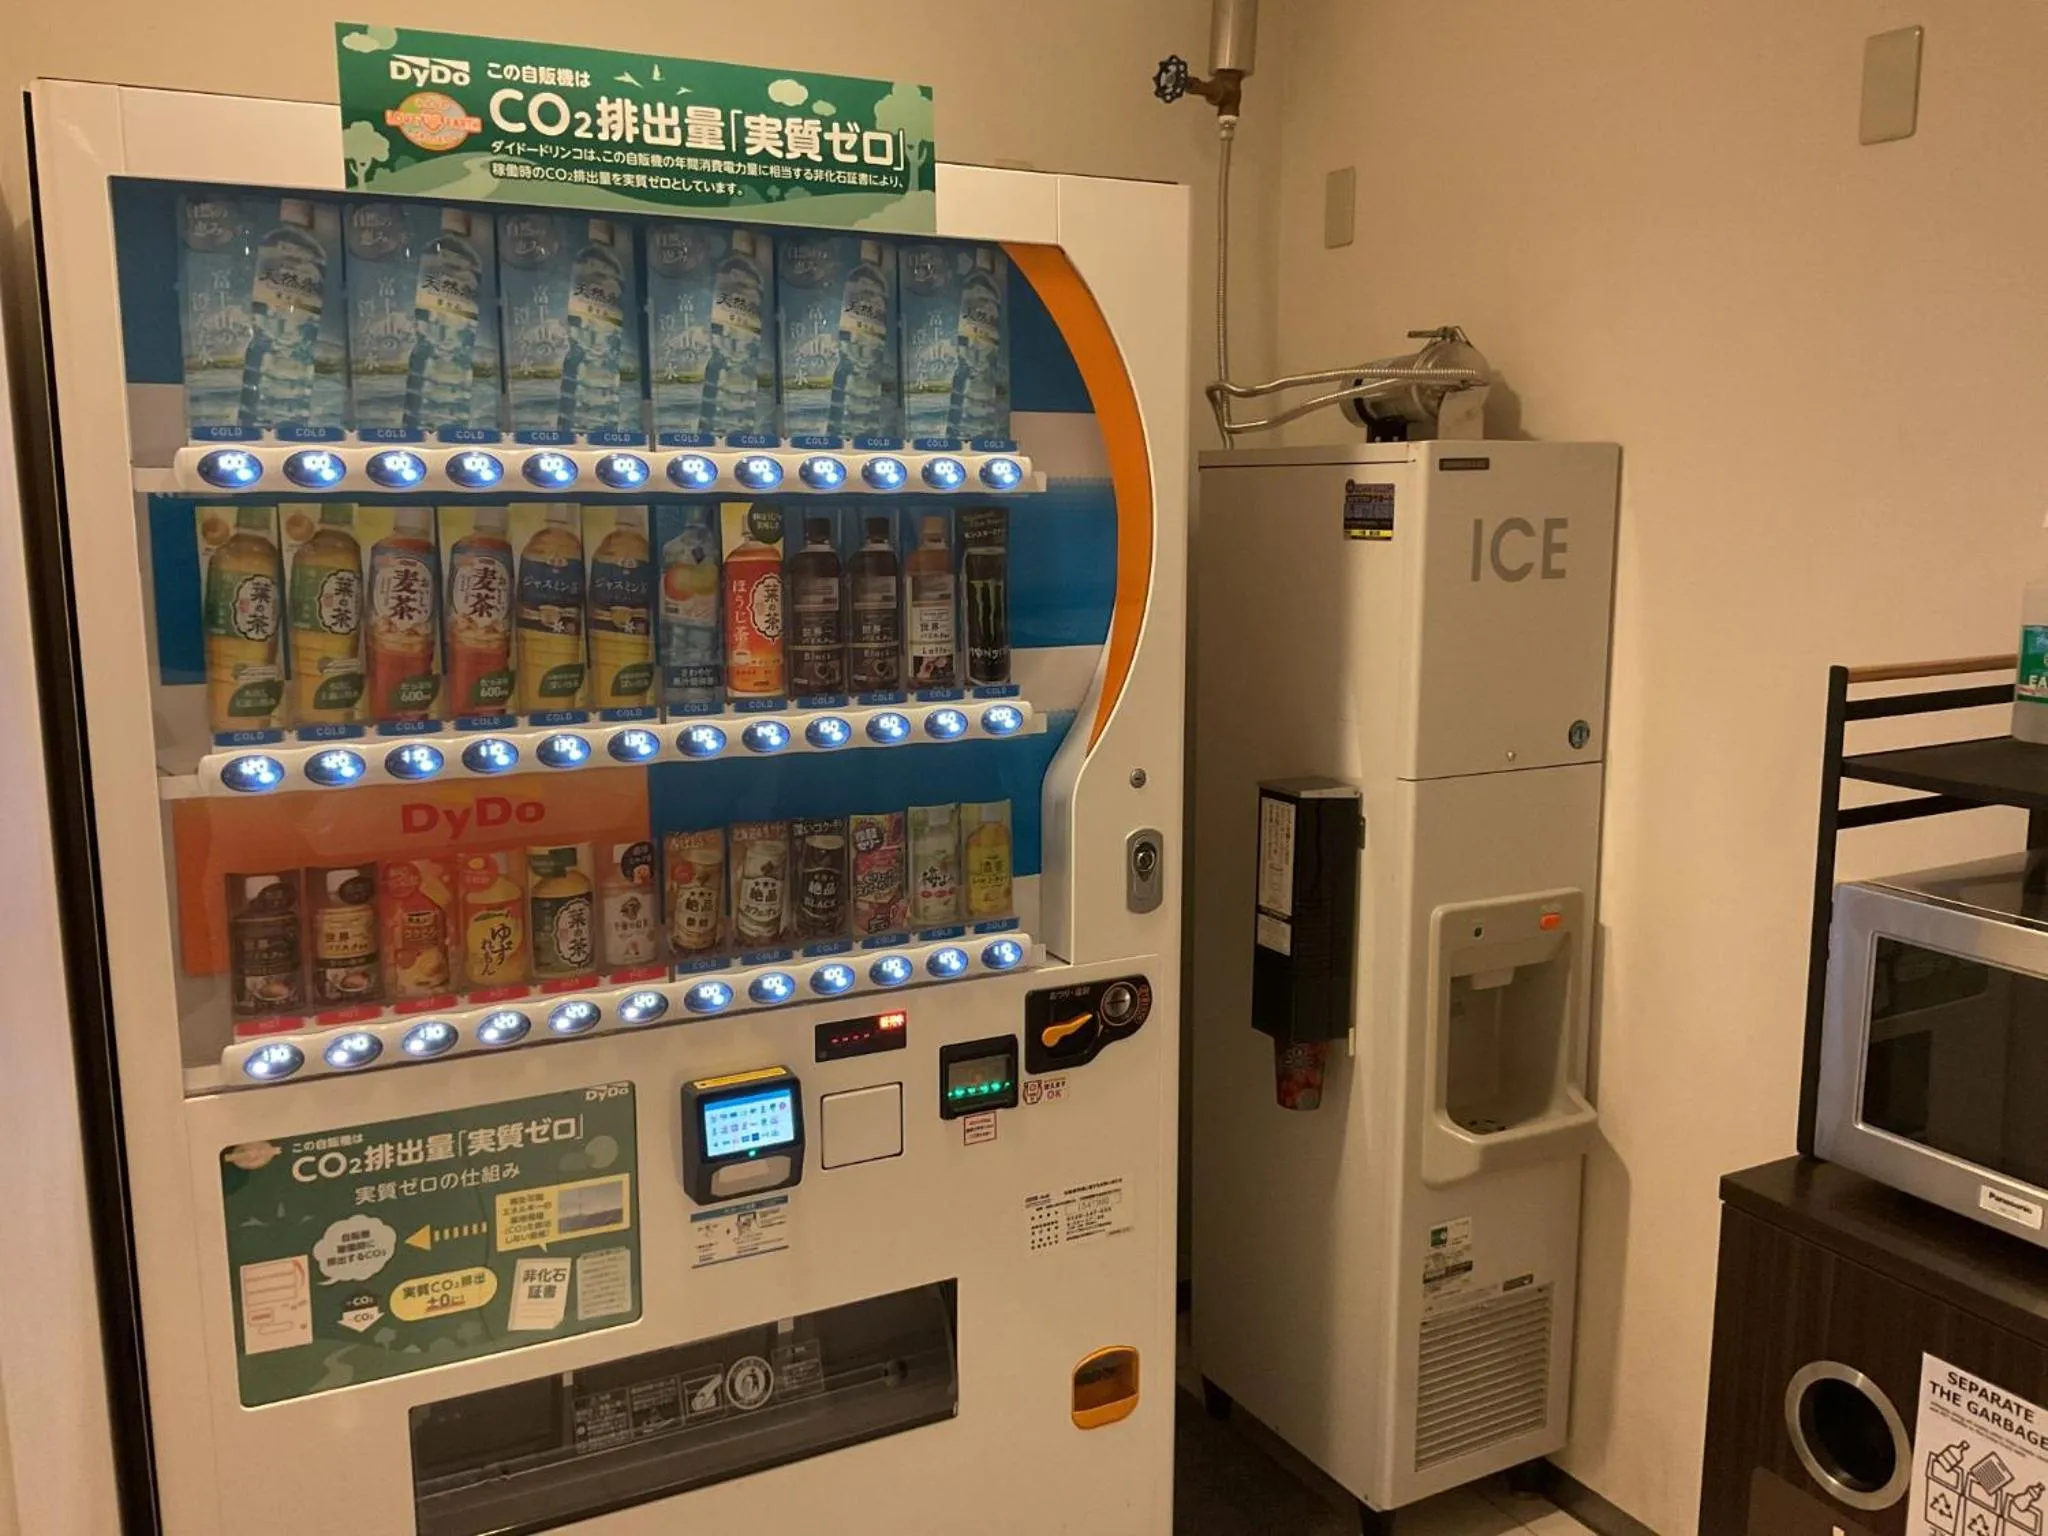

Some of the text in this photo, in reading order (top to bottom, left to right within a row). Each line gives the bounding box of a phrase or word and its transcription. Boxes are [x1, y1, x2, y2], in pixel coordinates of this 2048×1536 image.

[389, 55, 470, 87] DyDo
[487, 62, 591, 88] この自販機は
[211, 427, 242, 437] COLD
[296, 428, 326, 438] COLD
[377, 428, 407, 439] COLD
[456, 430, 485, 440] COLD
[531, 431, 559, 441] COLD
[604, 432, 630, 443] COLD
[674, 433, 700, 443] COLD
[741, 435, 766, 444] COLD
[805, 436, 829, 446] COLD
[868, 438, 890, 447] COLD
[926, 438, 949, 448] COLD
[983, 440, 1004, 449] COLD
[217, 453, 243, 470] 100
[303, 454, 329, 470] 100
[384, 455, 410, 471] 100
[463, 456, 488, 471] 100
[539, 458, 564, 472] 100
[613, 459, 634, 472] 100
[682, 459, 704, 473] 100
[749, 459, 769, 473] 100
[812, 460, 834, 474] 100
[874, 460, 896, 474] 100
[934, 460, 953, 474] 100
[990, 461, 1011, 475] 100
[1470, 517, 1569, 583] ICE
[388, 568, 421, 620] 麦茶
[469, 567, 500, 618] 麦茶
[246, 580, 273, 635] 葉の茶
[329, 576, 356, 629] 葉の茶
[764, 583, 781, 632] 葉の茶
[616, 708, 642, 718] COLD
[683, 703, 709, 713] COLD
[989, 708, 1012, 722] 200
[471, 716, 500, 727] COLD
[546, 712, 573, 722] COLD
[316, 726, 346, 737] COLD
[395, 721, 425, 731] COLD
[233, 732, 264, 742] COLD
[691, 729, 713, 744] 130
[553, 738, 577, 753] 130
[400, 797, 546, 841] DyDo
[803, 897, 837, 909] BLACK
[567, 906, 588, 958] 葉の茶
[489, 923, 514, 965] ゆず
[480, 937, 497, 977] れもん
[823, 967, 842, 981] 100
[763, 976, 783, 990] 100
[699, 985, 721, 999] 100
[585, 1083, 630, 1102] DyDo
[1046, 1089, 1063, 1099] OK
[291, 1132, 364, 1154] この自販機は
[354, 1160, 521, 1206] 実質ゼロの仕組み
[1988, 1191, 2033, 1214] Panasonic
[341, 1229, 371, 1242] 自販機
[522, 1267, 568, 1283] 非化石
[527, 1284, 557, 1300] 証書
[1947, 1371, 2036, 1424] SEPARATE
[1929, 1380, 2048, 1451] THE GARBAGE
